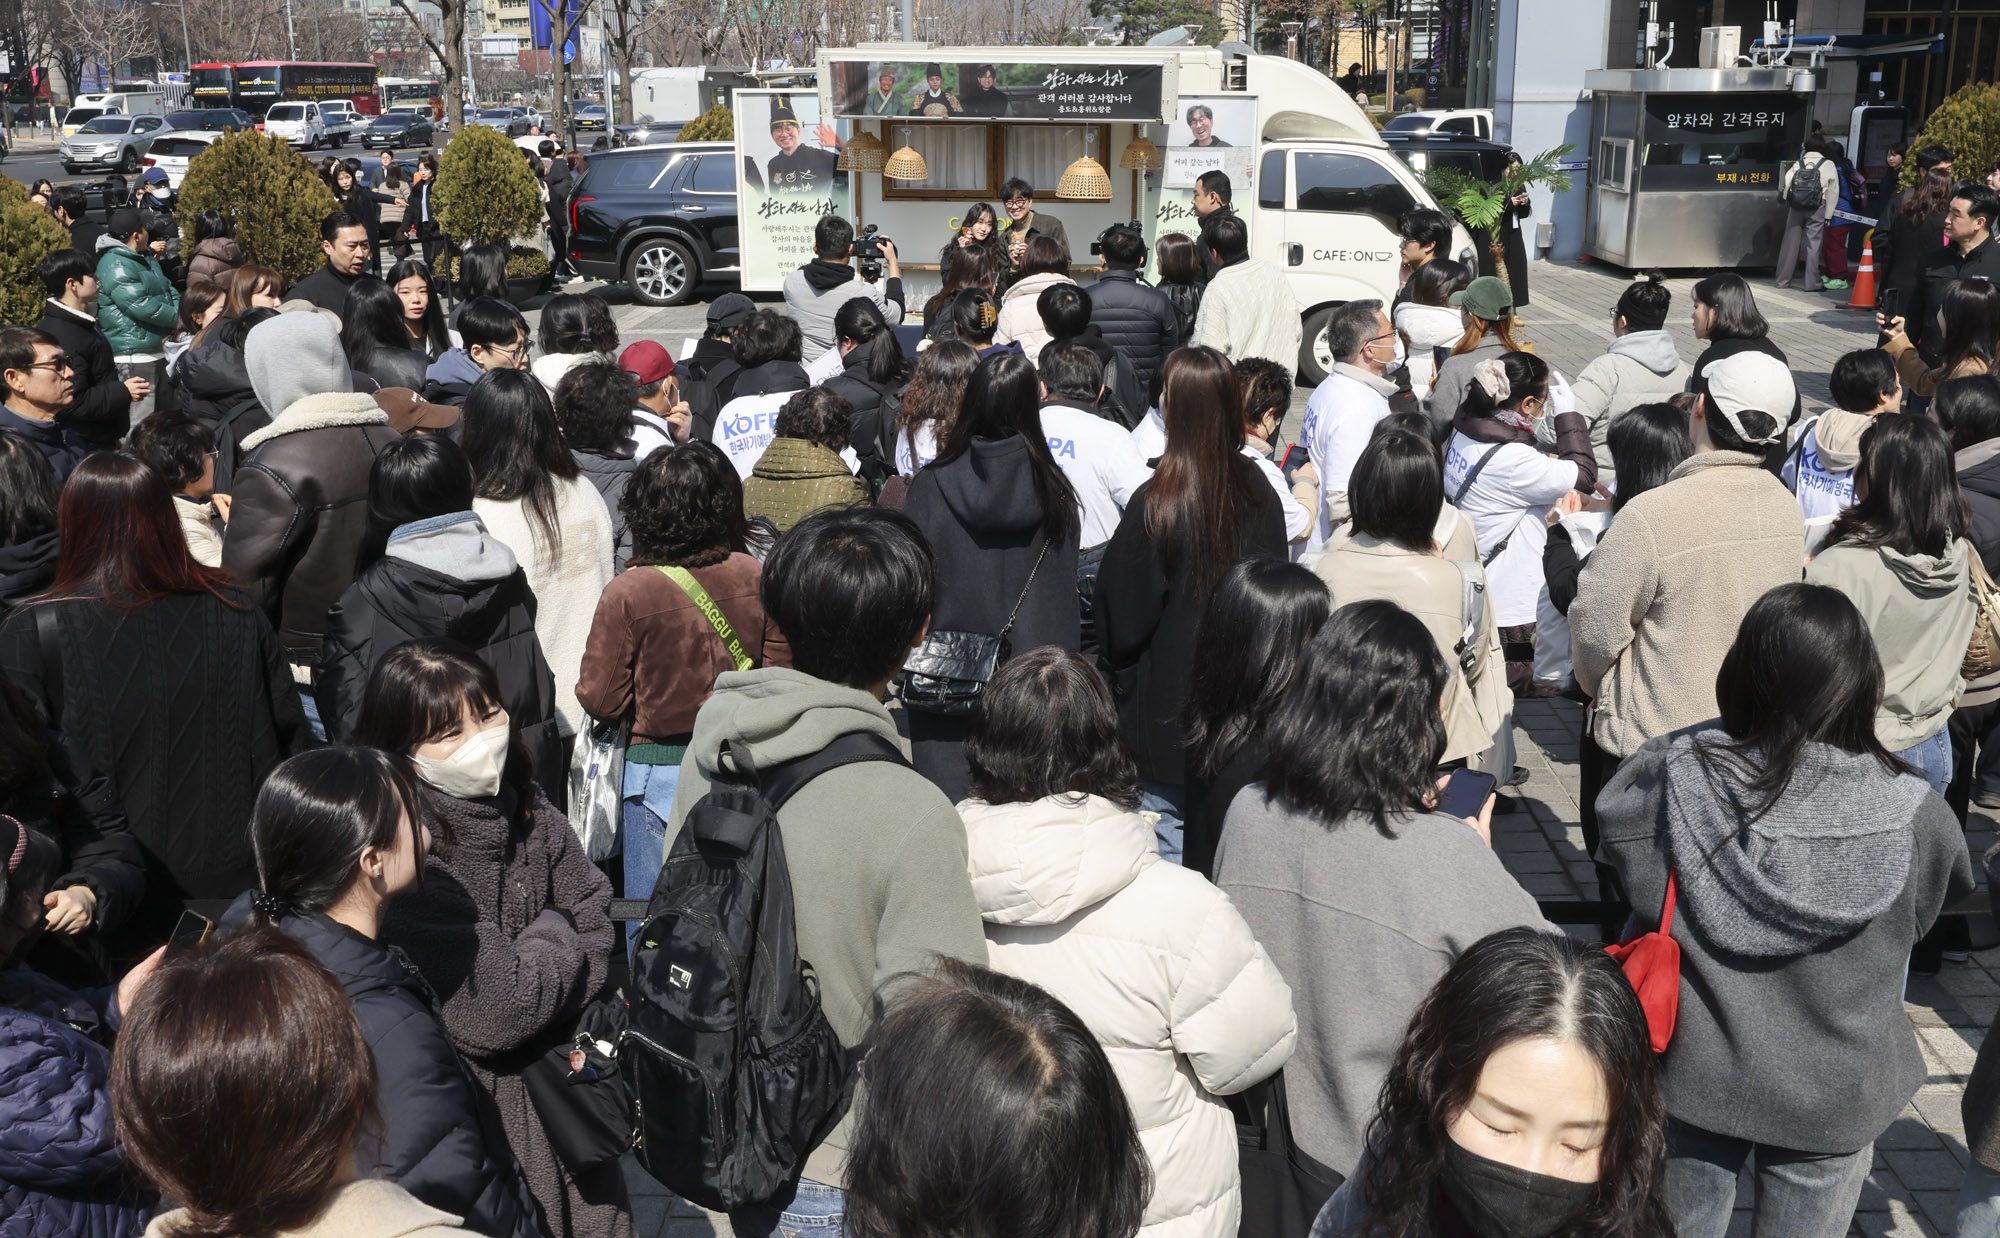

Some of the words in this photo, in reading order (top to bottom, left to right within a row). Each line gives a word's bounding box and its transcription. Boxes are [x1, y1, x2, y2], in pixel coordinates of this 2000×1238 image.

[297, 85, 314, 94] SEOUL
[315, 85, 326, 94] CITY
[327, 85, 340, 94] TOUR
[341, 85, 350, 93] BUS
[1037, 93, 1056, 103] 관객
[1058, 93, 1085, 103] 여러분
[1087, 93, 1133, 104] 감사합니다
[1667, 112, 1713, 128] 앞차와
[1722, 111, 1785, 127] 간격유지
[1205, 158, 1220, 167] 남자
[1716, 173, 1737, 183] 부재
[1739, 175, 1748, 183] 시
[1750, 172, 1771, 183] 전화
[757, 196, 786, 219] 왕과
[761, 225, 801, 233] 사랑해주시는
[1313, 249, 1374, 262] CAFE:ON
[695, 592, 732, 638] BAGGU
